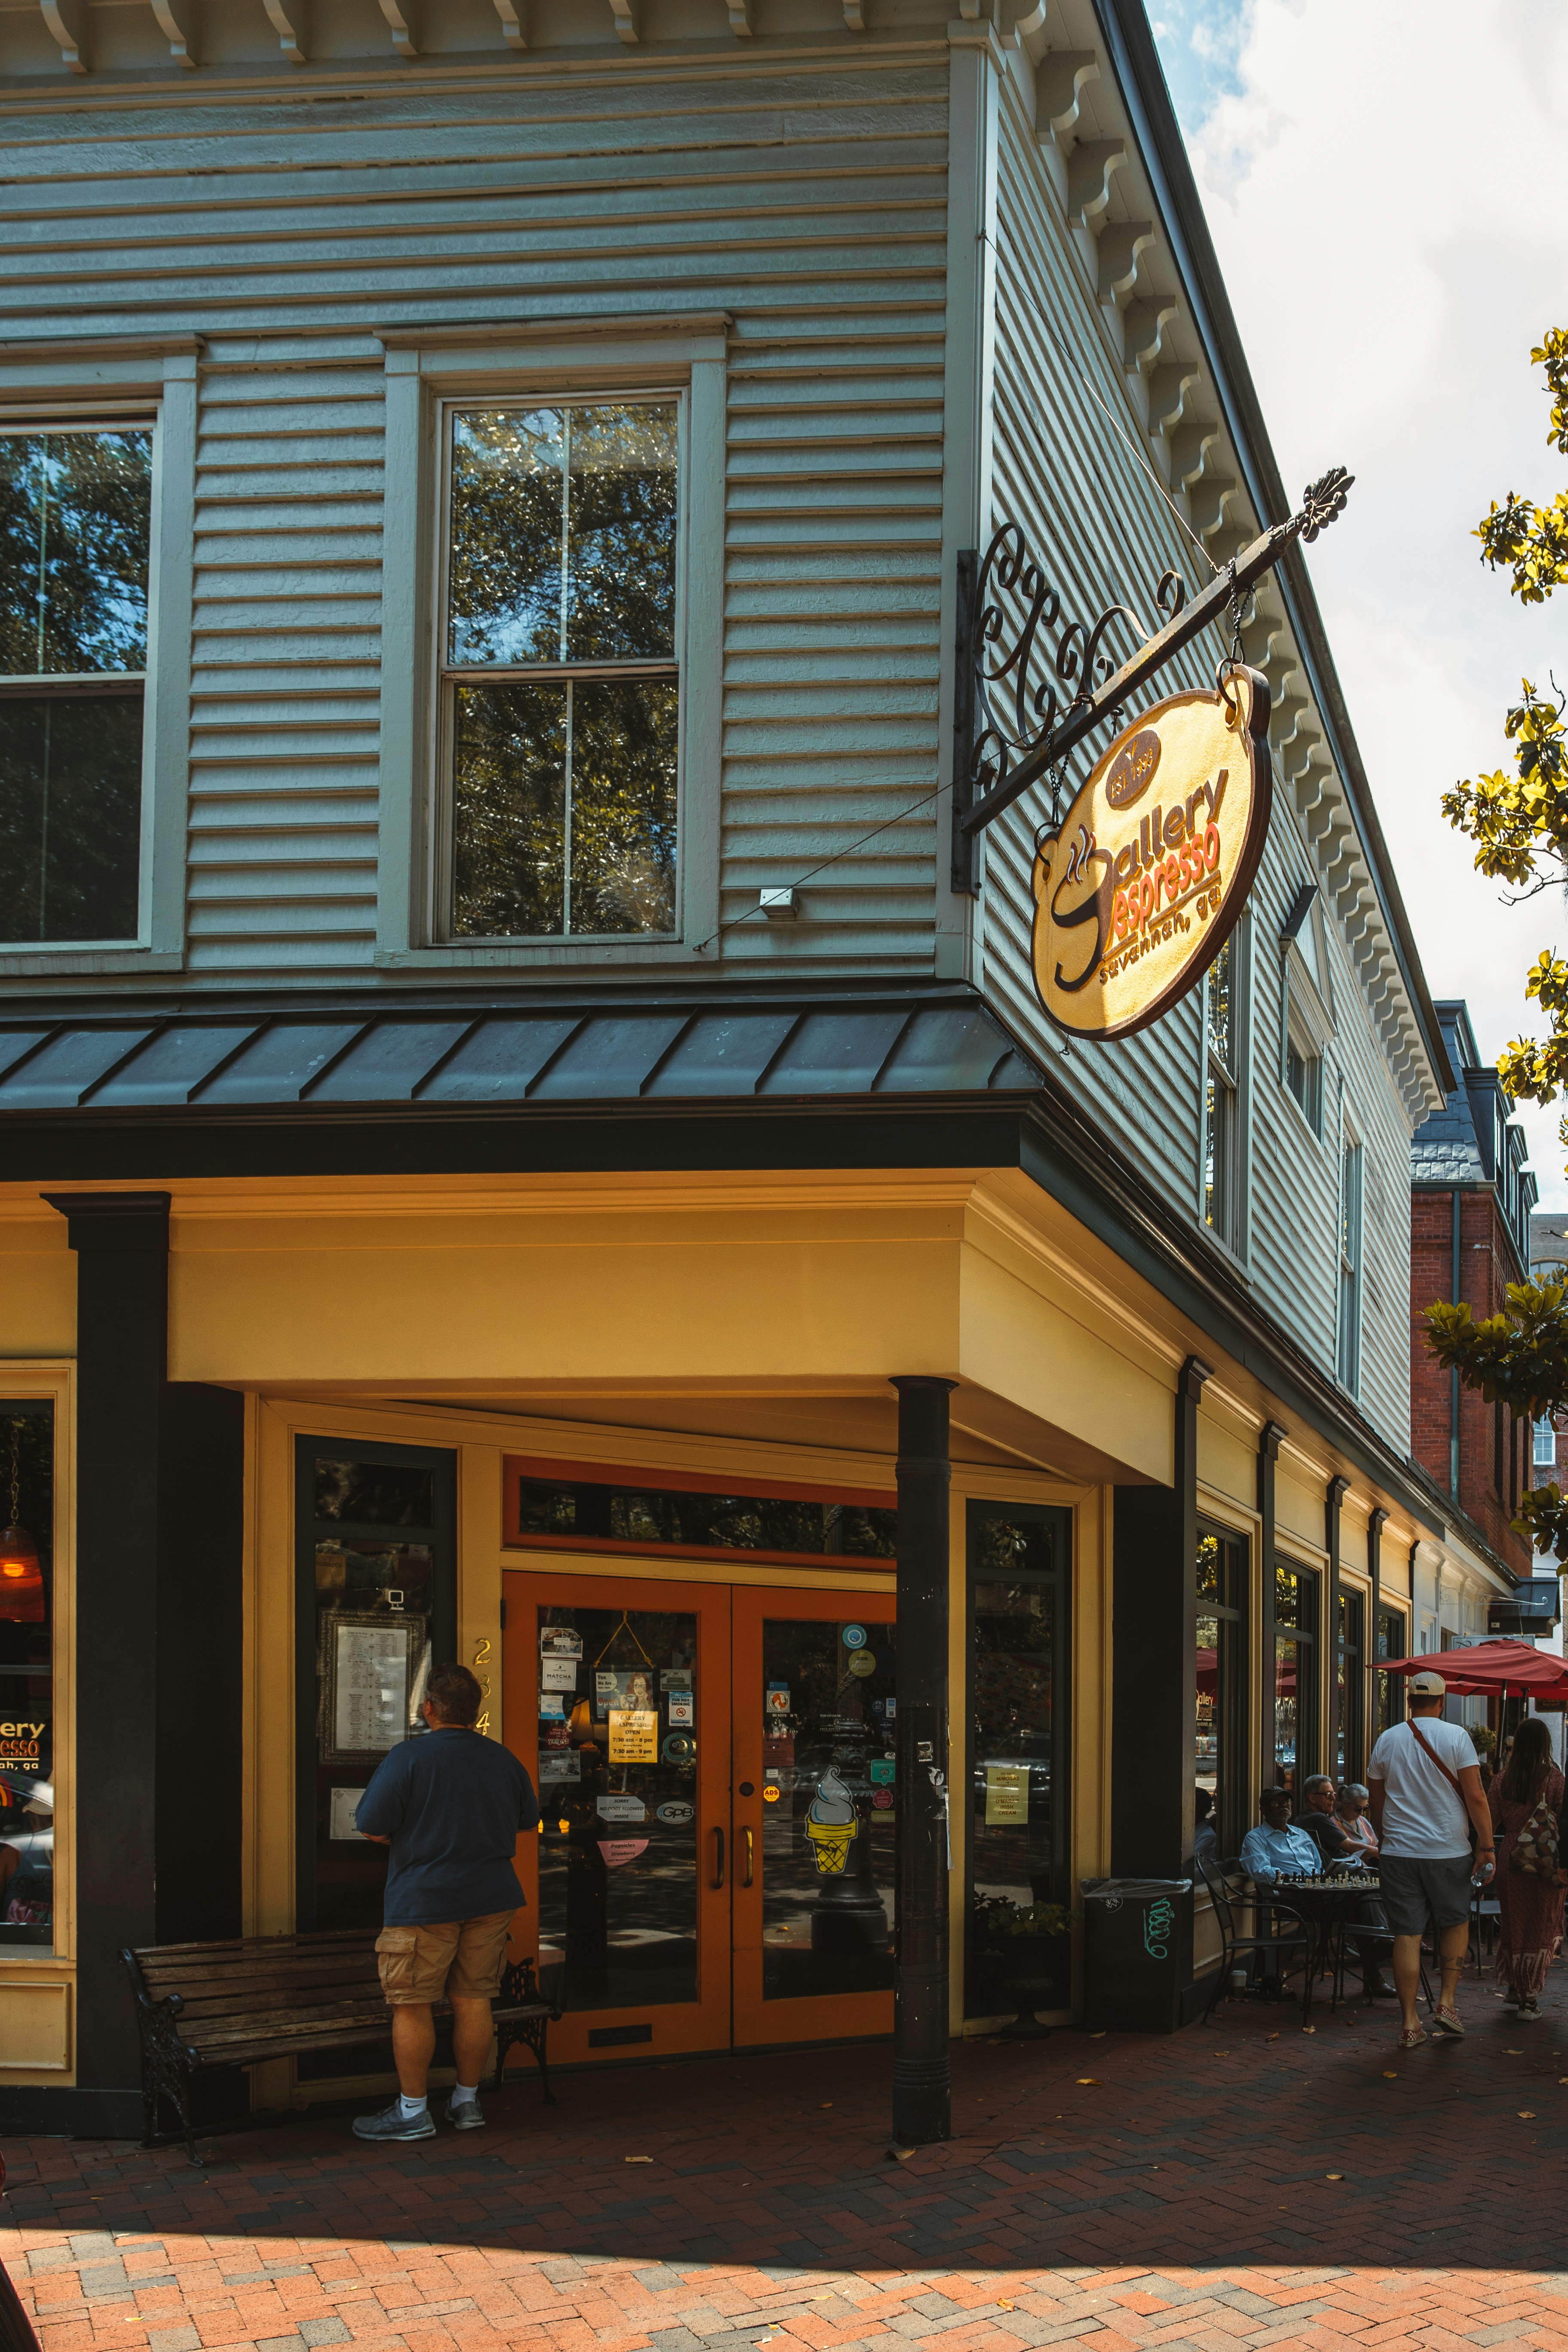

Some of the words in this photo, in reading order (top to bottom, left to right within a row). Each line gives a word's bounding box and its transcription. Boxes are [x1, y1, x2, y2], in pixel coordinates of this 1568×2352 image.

[1131, 747, 1153, 781] 1993
[1114, 822, 1219, 937] espresso
[1197, 884, 1222, 919] ga
[598, 1697, 619, 1708] Open
[663, 1807, 693, 1818] GPB
